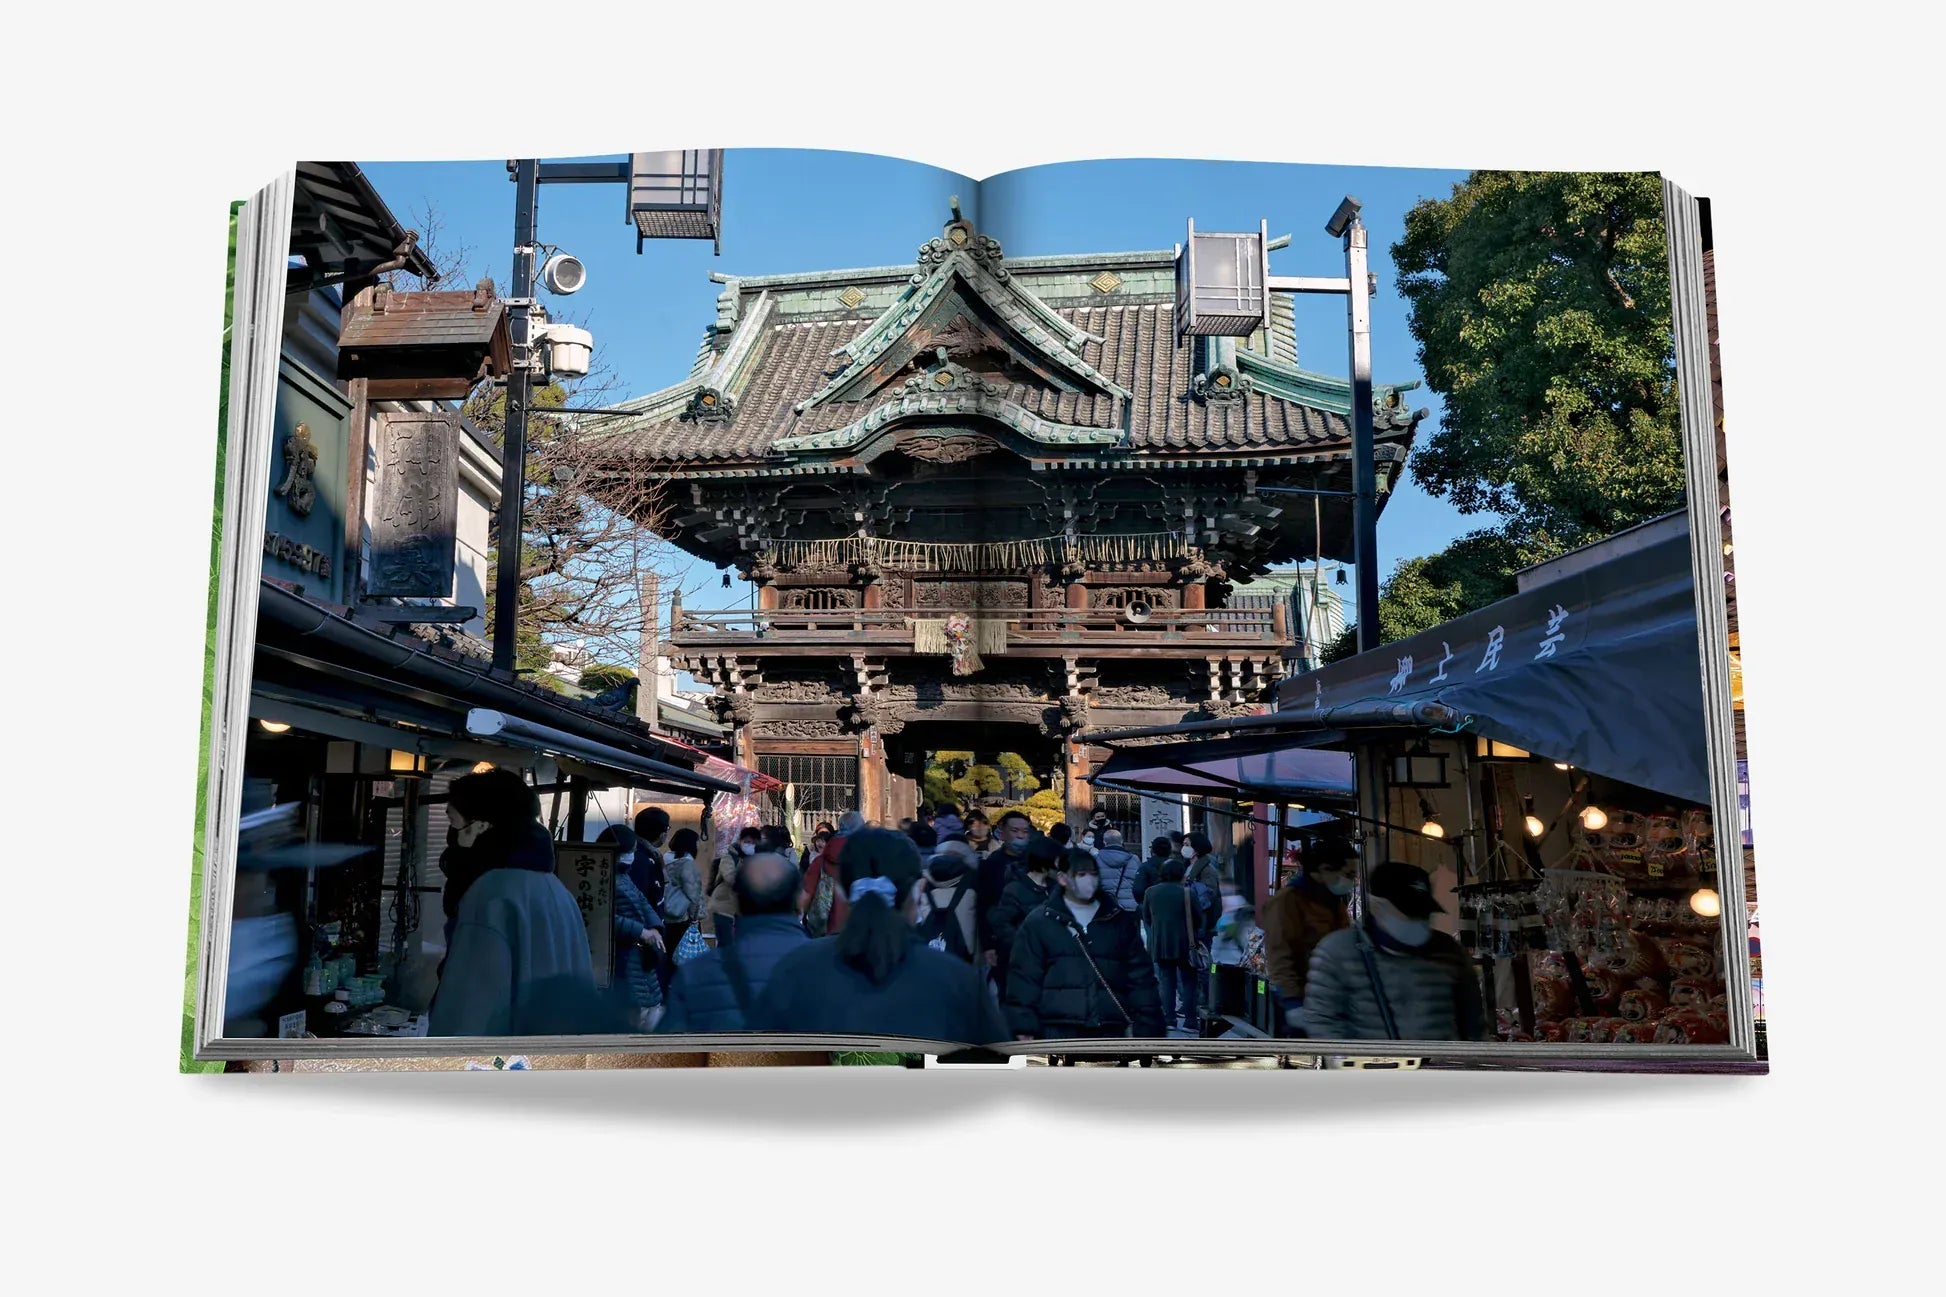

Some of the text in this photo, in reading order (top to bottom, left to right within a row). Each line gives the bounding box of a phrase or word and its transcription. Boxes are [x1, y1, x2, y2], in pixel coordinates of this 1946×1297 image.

[598, 857, 610, 906] ありがたい
